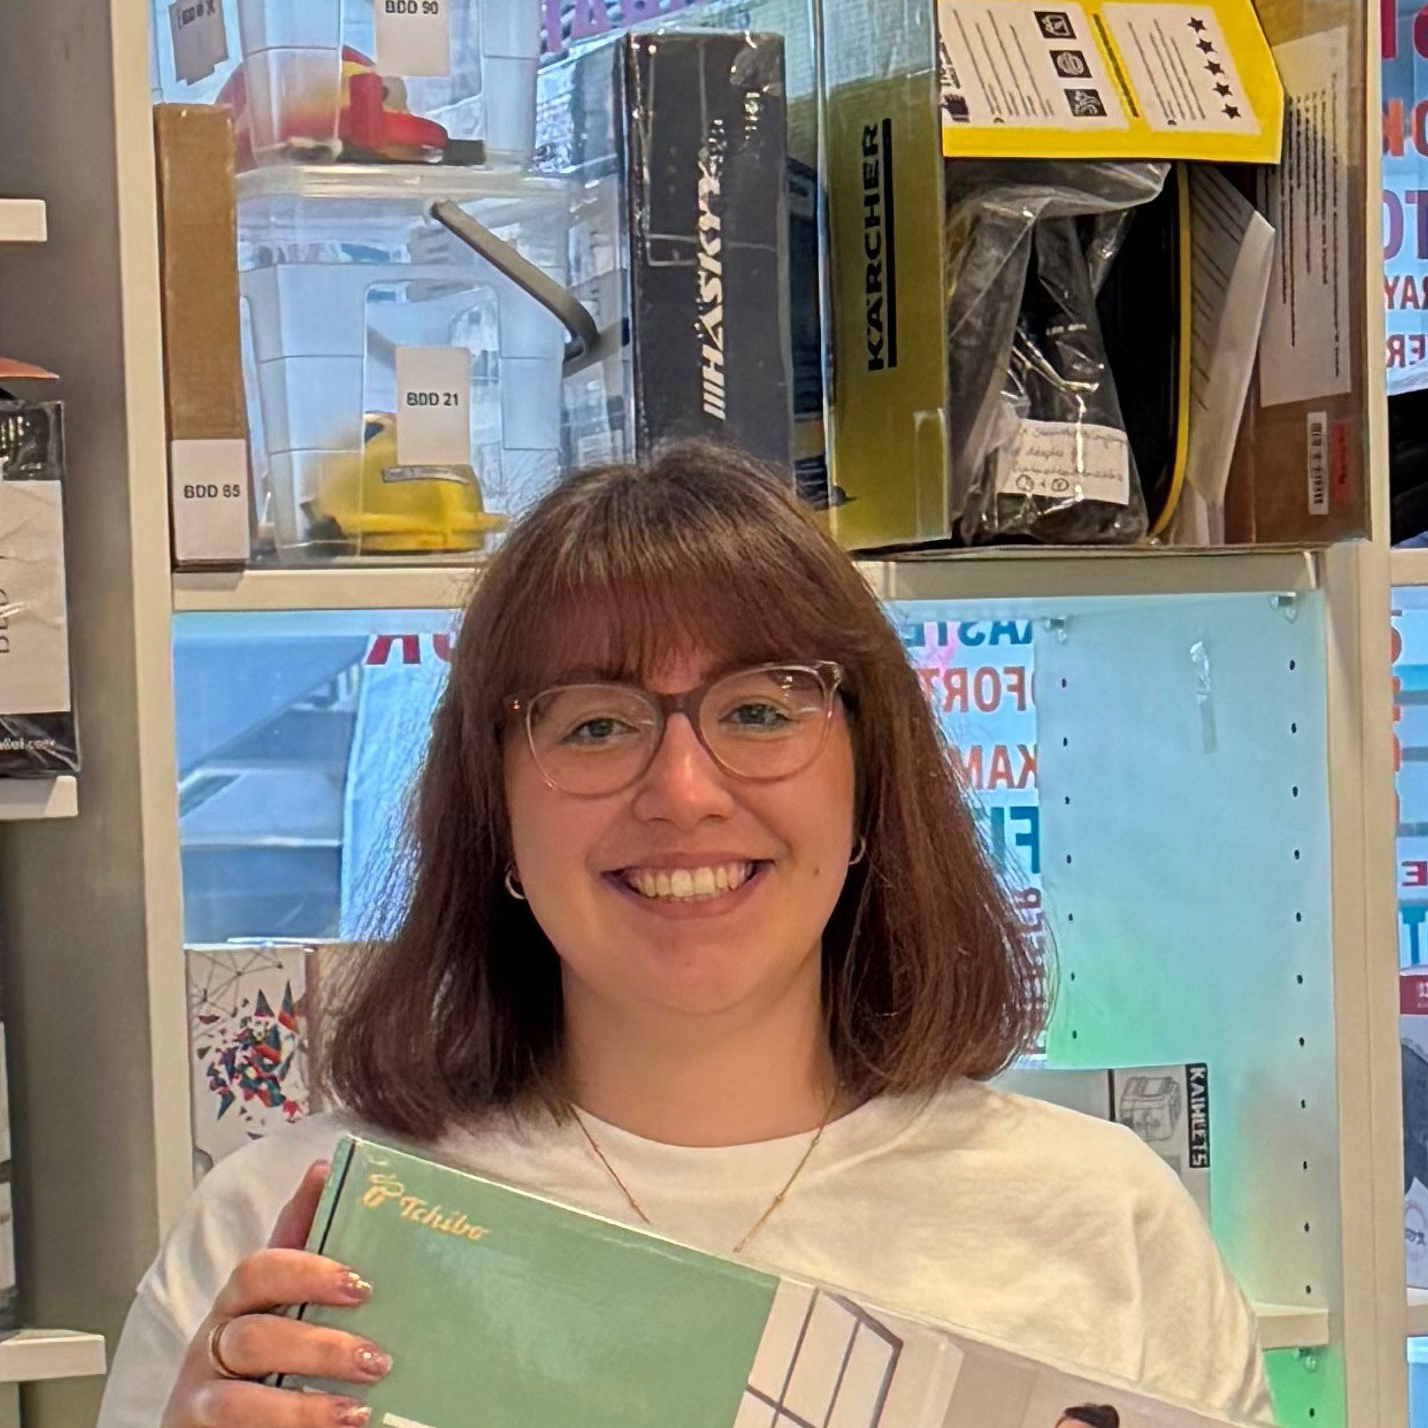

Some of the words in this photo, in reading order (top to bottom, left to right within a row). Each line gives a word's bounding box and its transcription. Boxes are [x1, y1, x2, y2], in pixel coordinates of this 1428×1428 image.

[385, 1, 417, 14] BDD
[407, 392, 439, 406] BDD
[443, 391, 459, 406] 21
[184, 485, 217, 498] BDD
[400, 1191, 491, 1242] Tchibo
